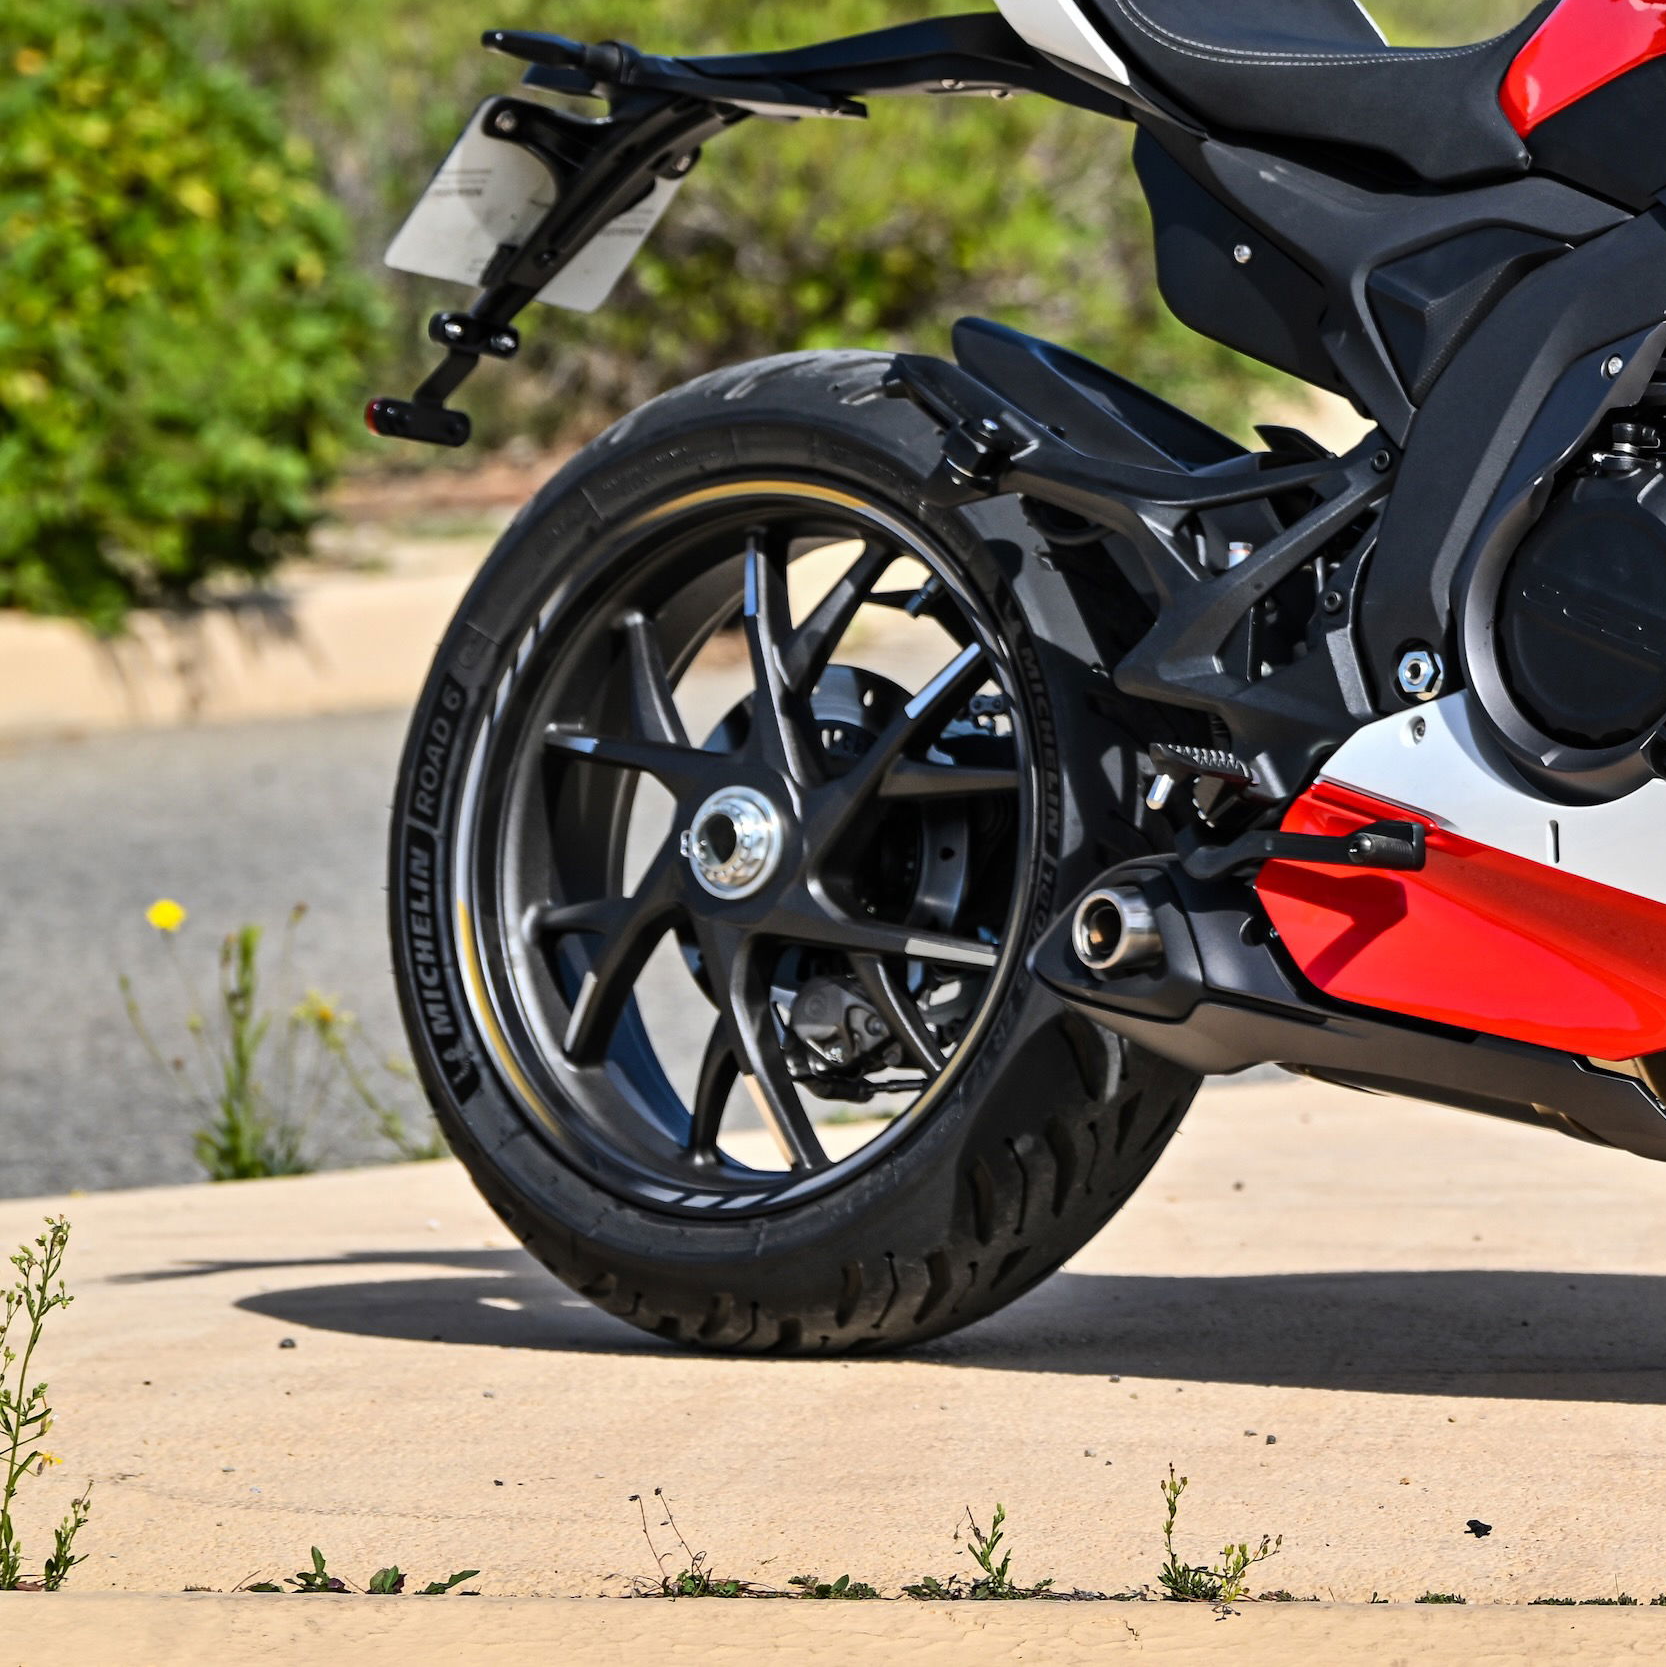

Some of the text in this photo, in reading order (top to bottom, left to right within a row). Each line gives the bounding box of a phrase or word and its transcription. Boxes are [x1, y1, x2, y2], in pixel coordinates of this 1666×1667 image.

[410, 687, 463, 1036] MICHELIN ROAD 6
[1020, 645, 1059, 840] MICHELIN
